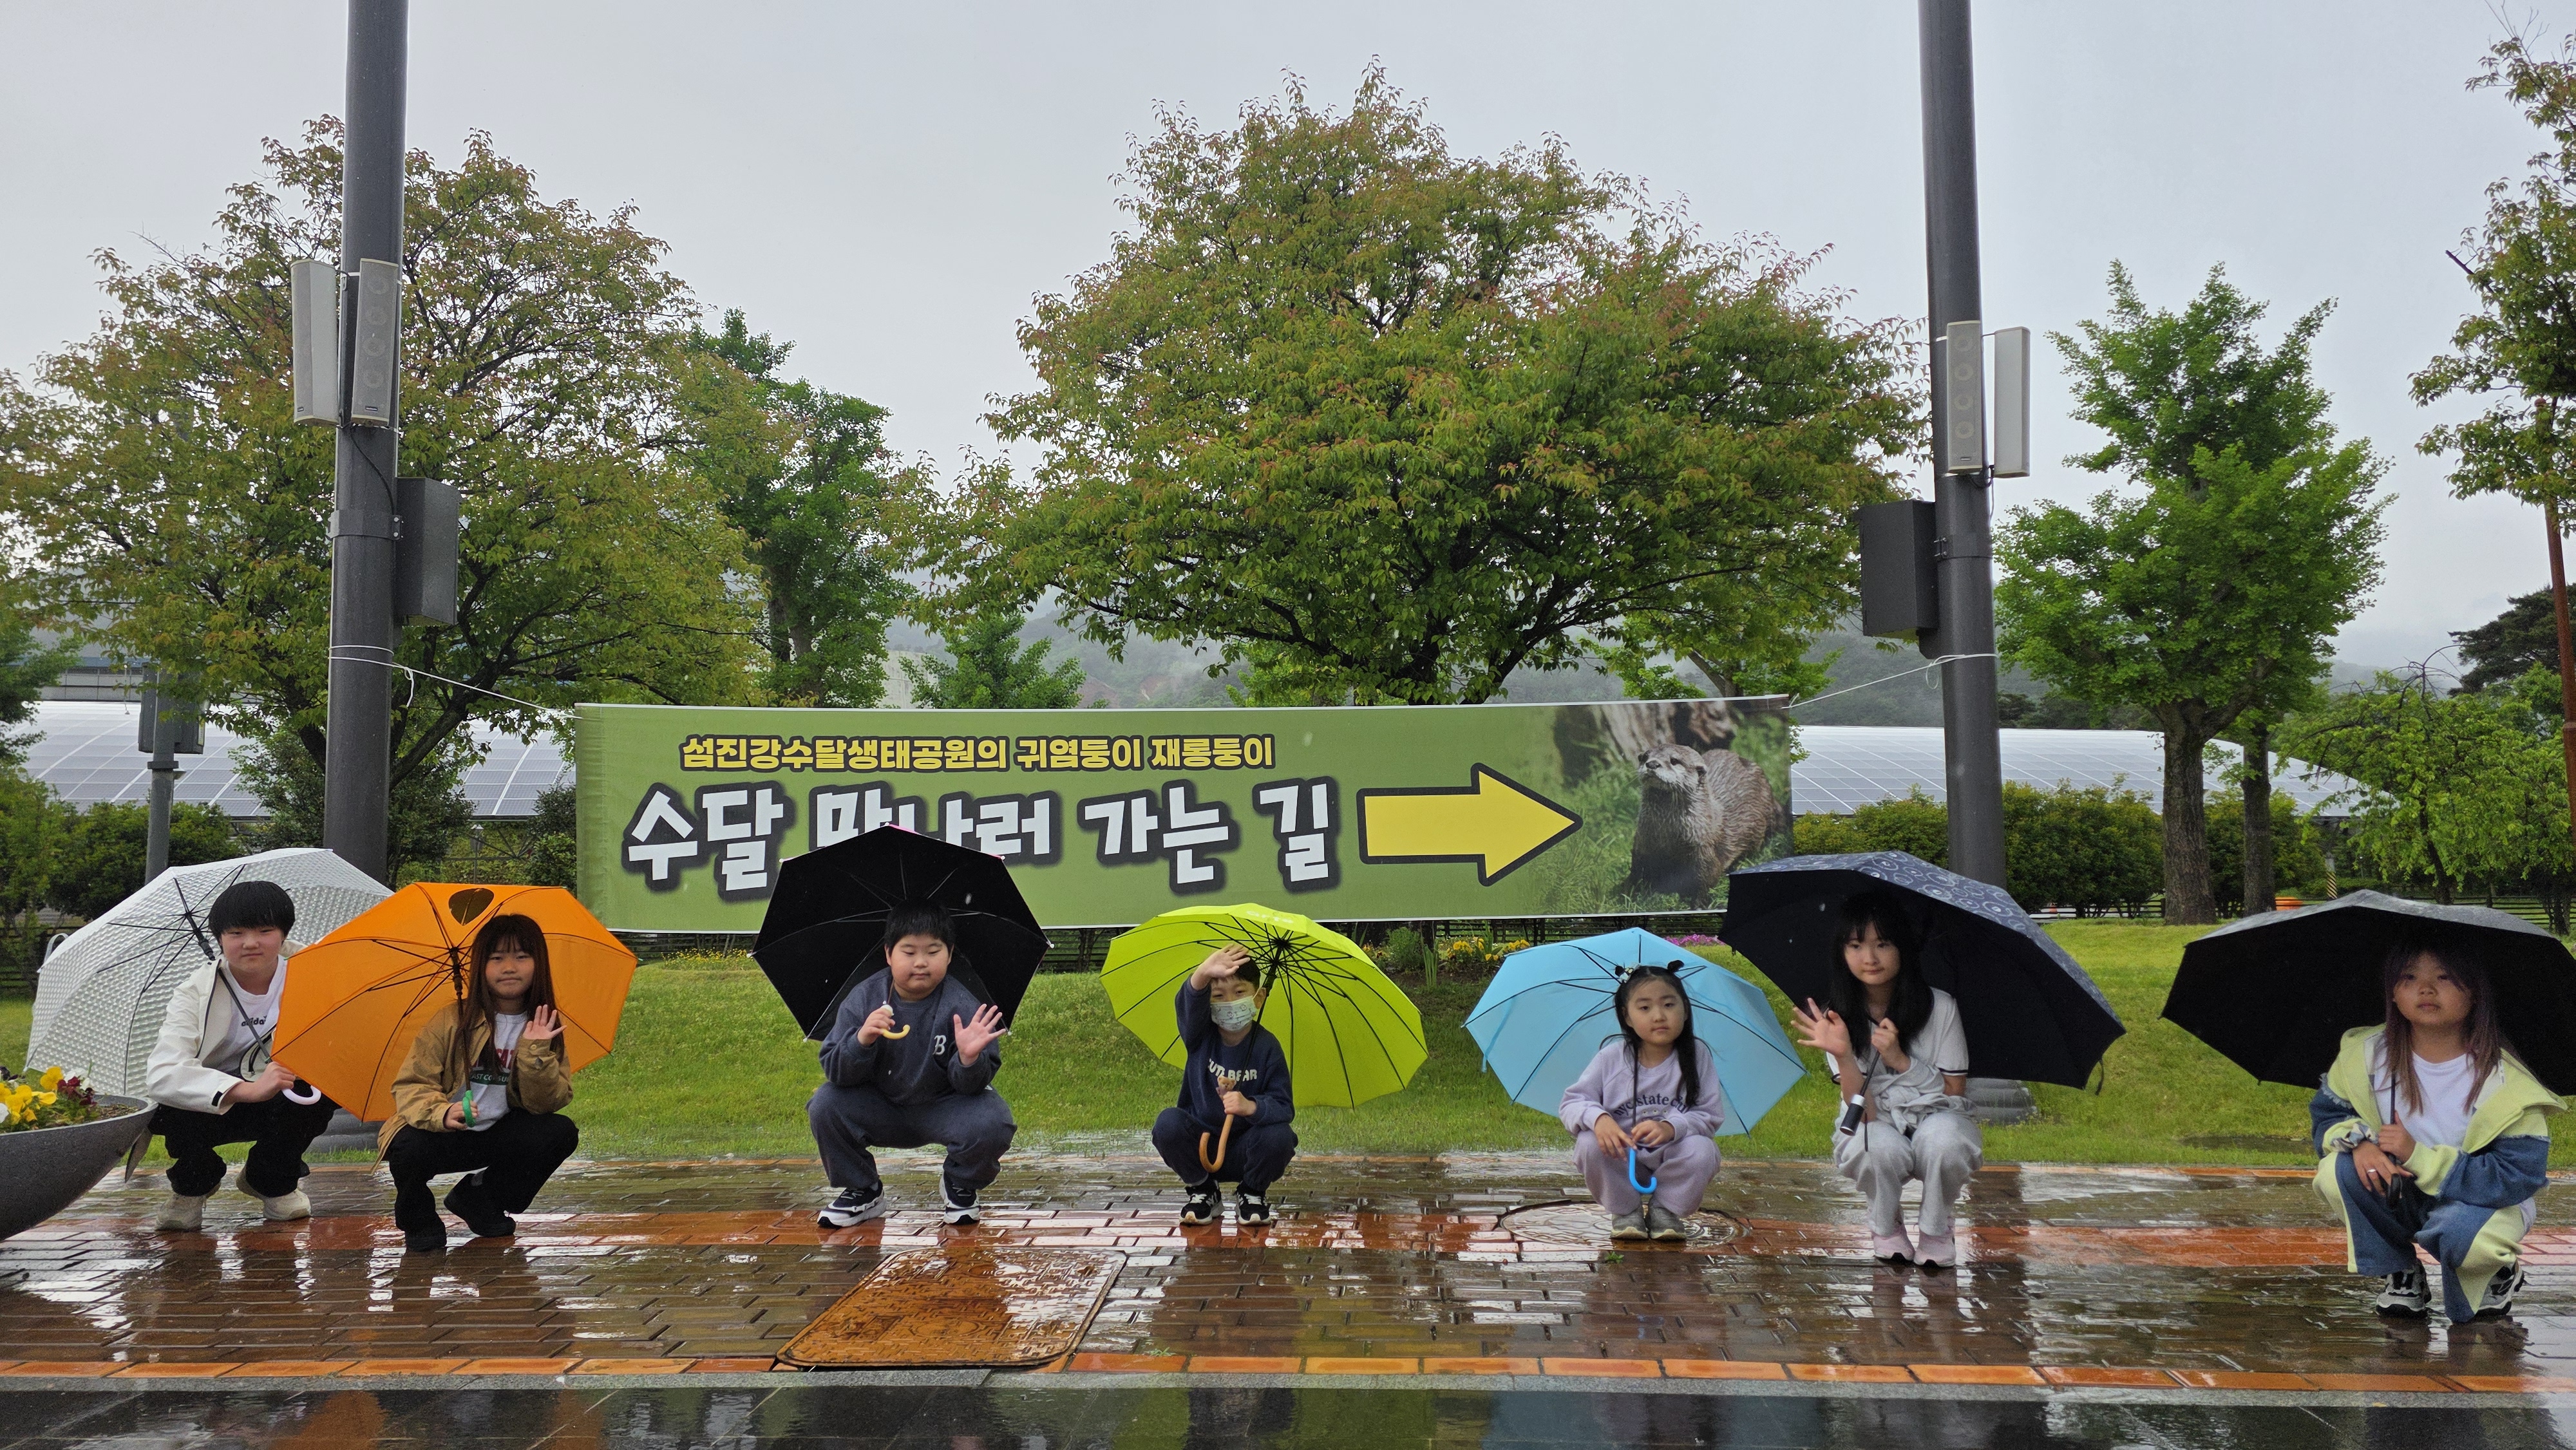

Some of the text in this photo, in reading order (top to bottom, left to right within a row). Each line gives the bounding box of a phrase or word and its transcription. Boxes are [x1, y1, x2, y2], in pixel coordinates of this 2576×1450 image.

[683, 737, 1272, 769] 섬진강수달생태공원의 귀염둥이 재롱둥이
[628, 787, 784, 892] 수달
[1084, 786, 1229, 885] 가는
[1259, 783, 1329, 883] 길
[932, 1035, 947, 1055] B
[1227, 1069, 1257, 1082] BEAR
[1636, 1093, 1669, 1107] state
